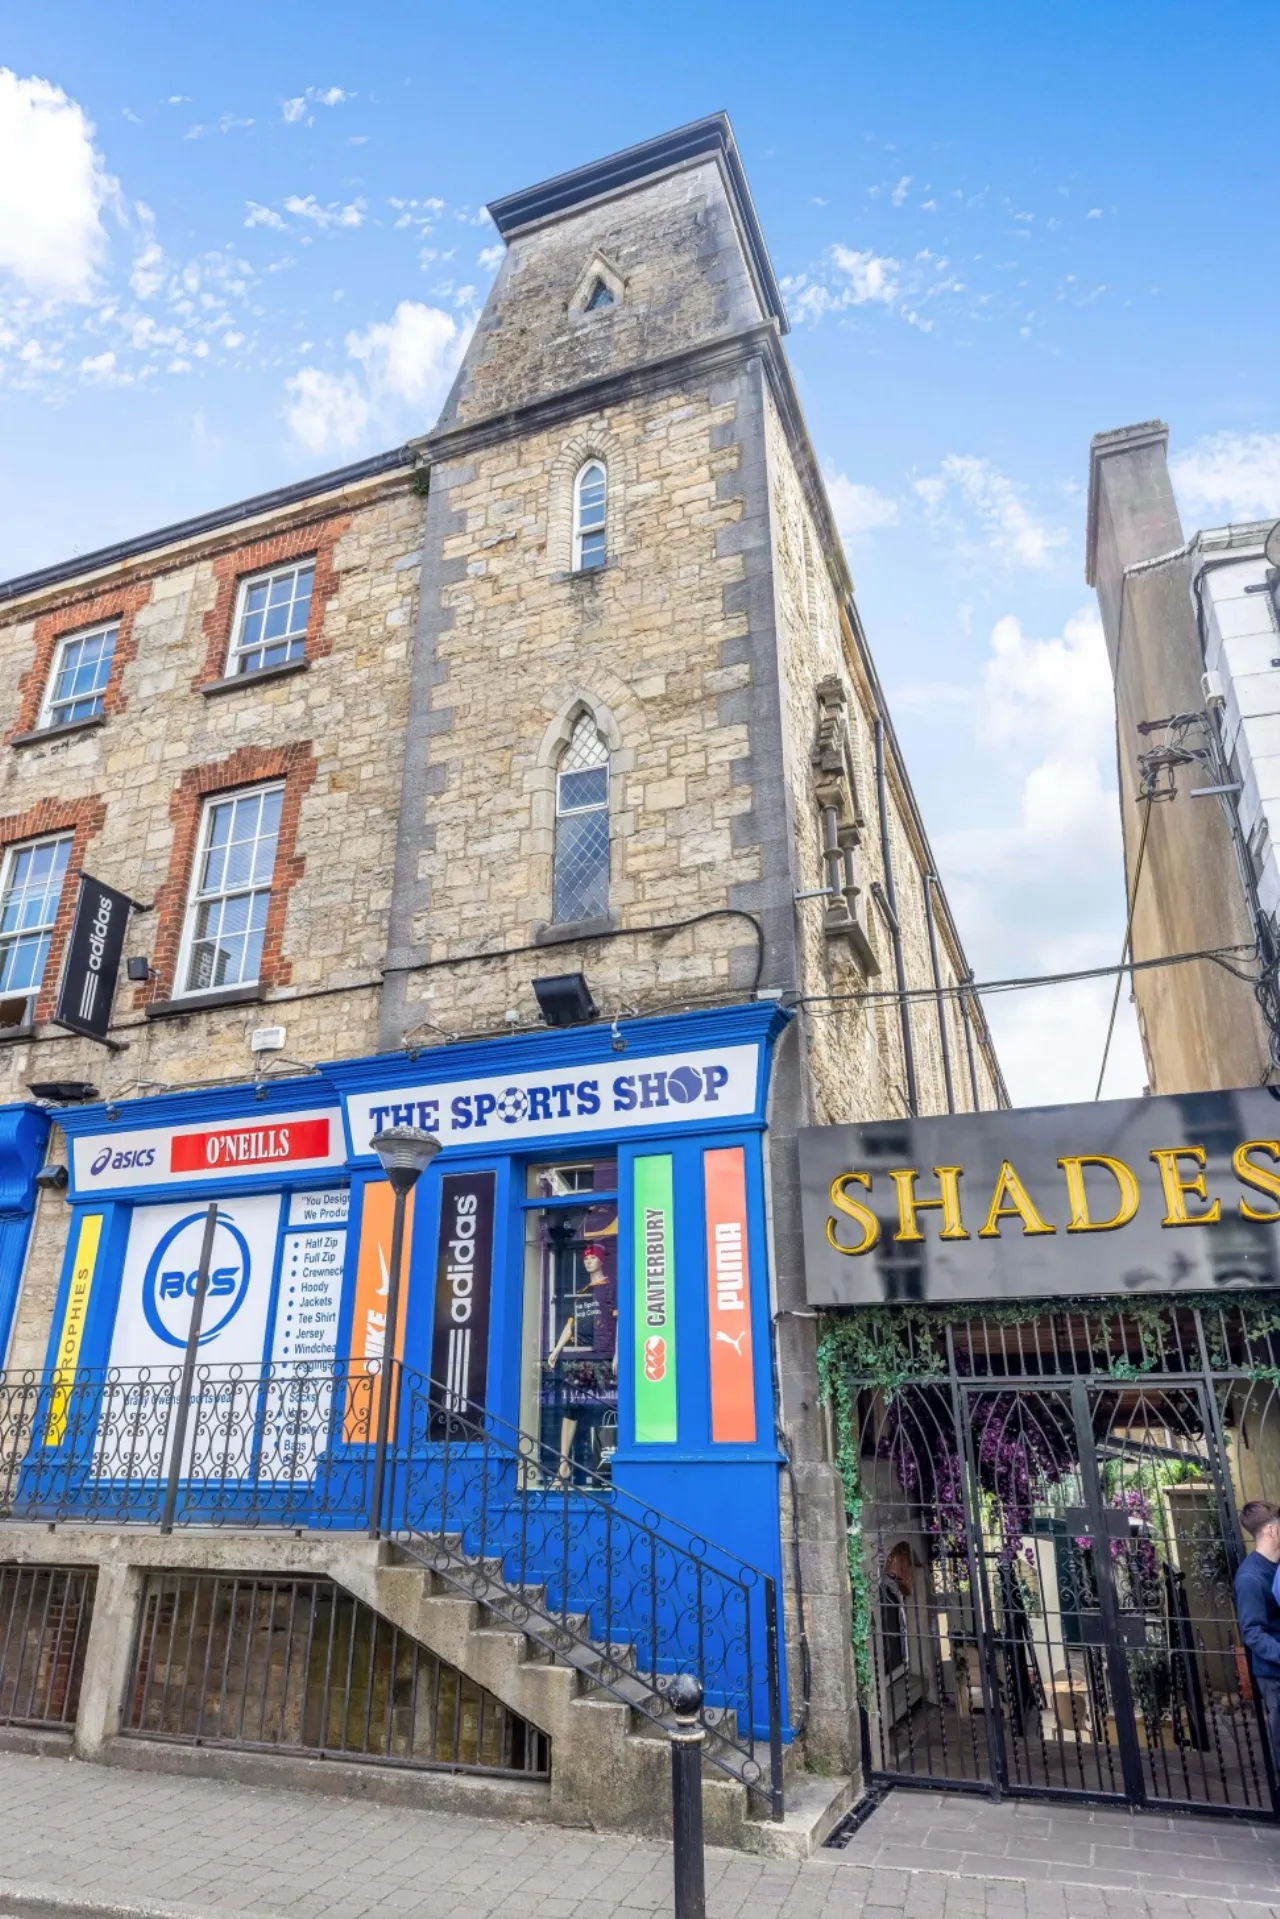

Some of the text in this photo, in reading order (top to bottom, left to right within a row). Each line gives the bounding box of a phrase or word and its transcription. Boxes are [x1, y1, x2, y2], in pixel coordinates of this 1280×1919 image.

[89, 895, 112, 970] adidas
[369, 1065, 729, 1134] THE SPORTS SHOP
[206, 1129, 290, 1165] O'NEILLS
[826, 1139, 1280, 1256] SHADES
[304, 1210, 317, 1220] We
[305, 1237, 338, 1249] Half Zip
[303, 1252, 336, 1264] Full Zip
[446, 1193, 478, 1323] adidas
[646, 1209, 667, 1328] CANTERBURY
[715, 1222, 745, 1311] PUMA
[301, 1281, 329, 1294] Hoody
[299, 1297, 333, 1307] Jackets
[298, 1312, 337, 1323] Tee Shirt
[296, 1328, 325, 1340] Jersey
